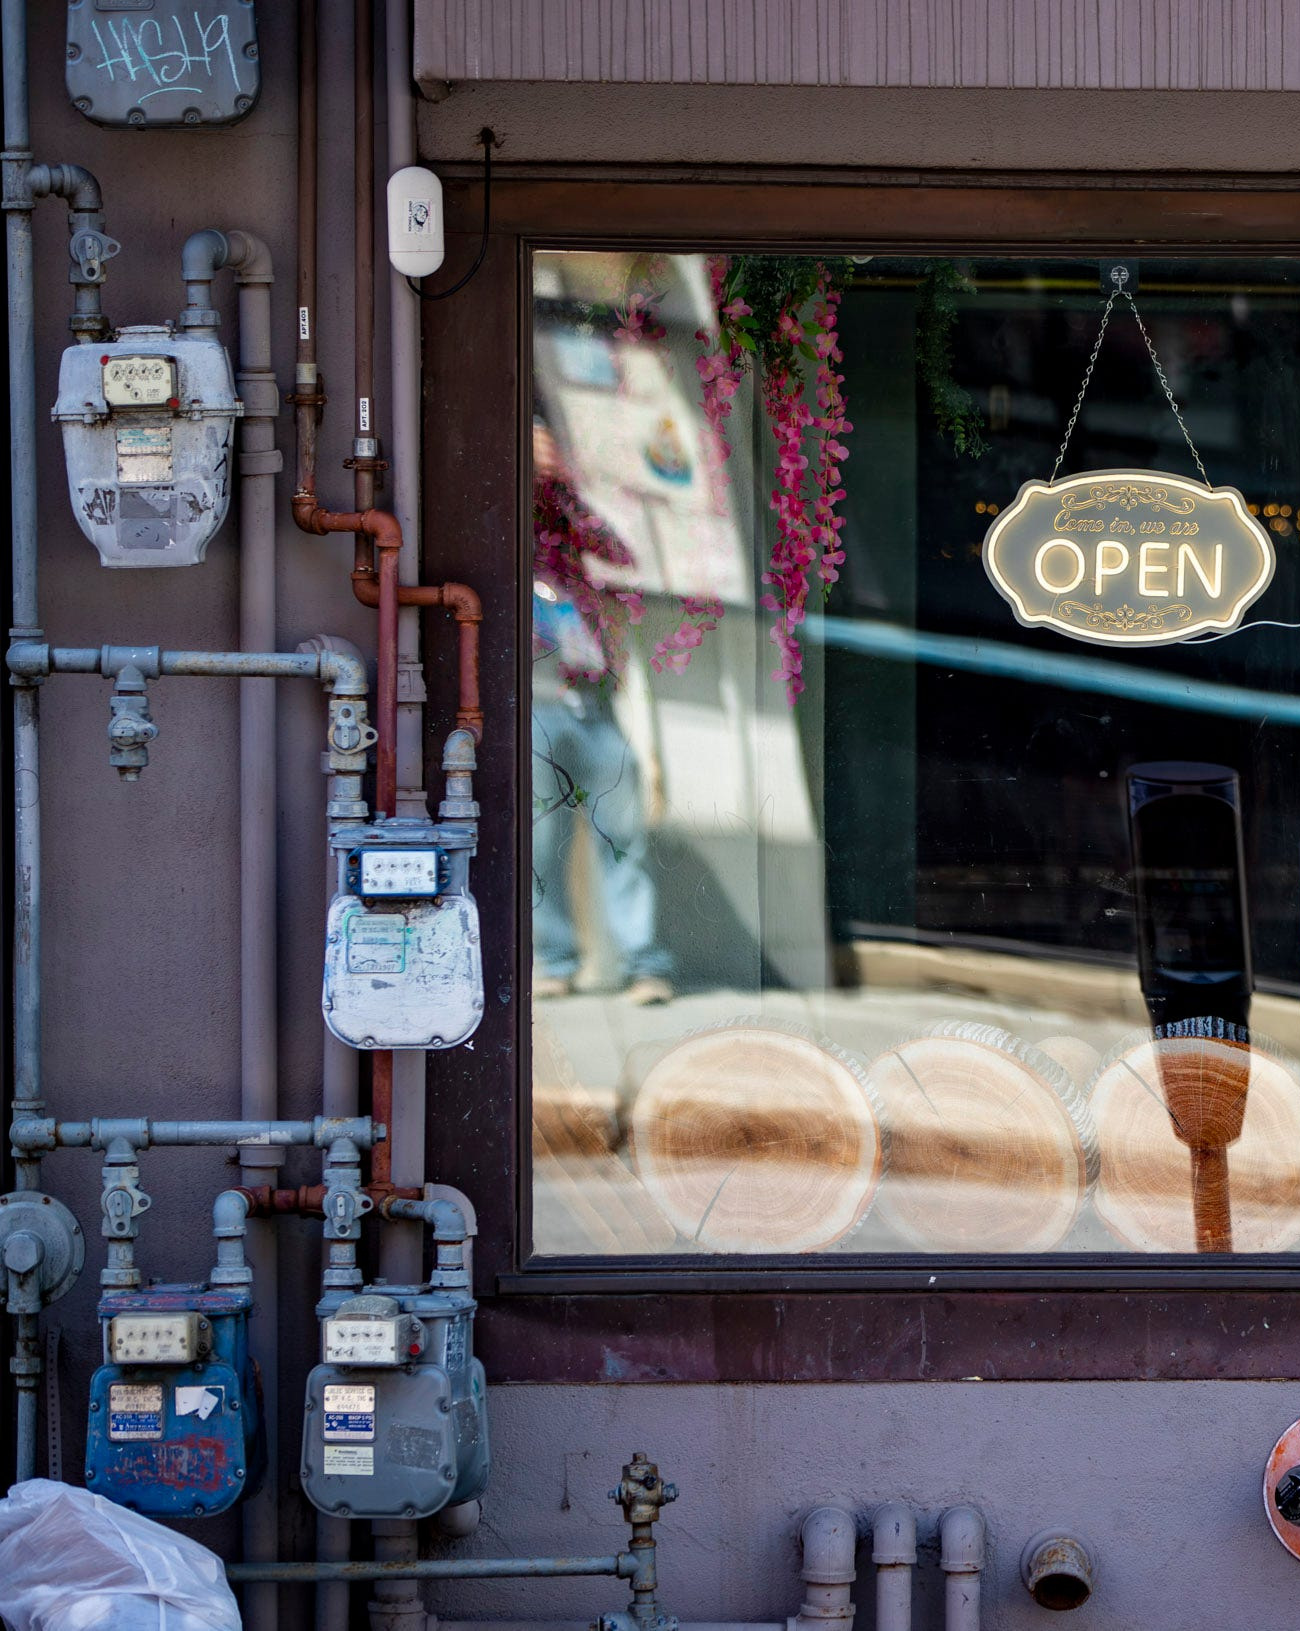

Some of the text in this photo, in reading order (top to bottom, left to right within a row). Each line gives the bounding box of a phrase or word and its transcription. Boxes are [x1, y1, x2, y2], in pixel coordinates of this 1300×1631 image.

[1053, 508, 1200, 536] Come in, we are
[1034, 538, 1223, 599] OPEN
